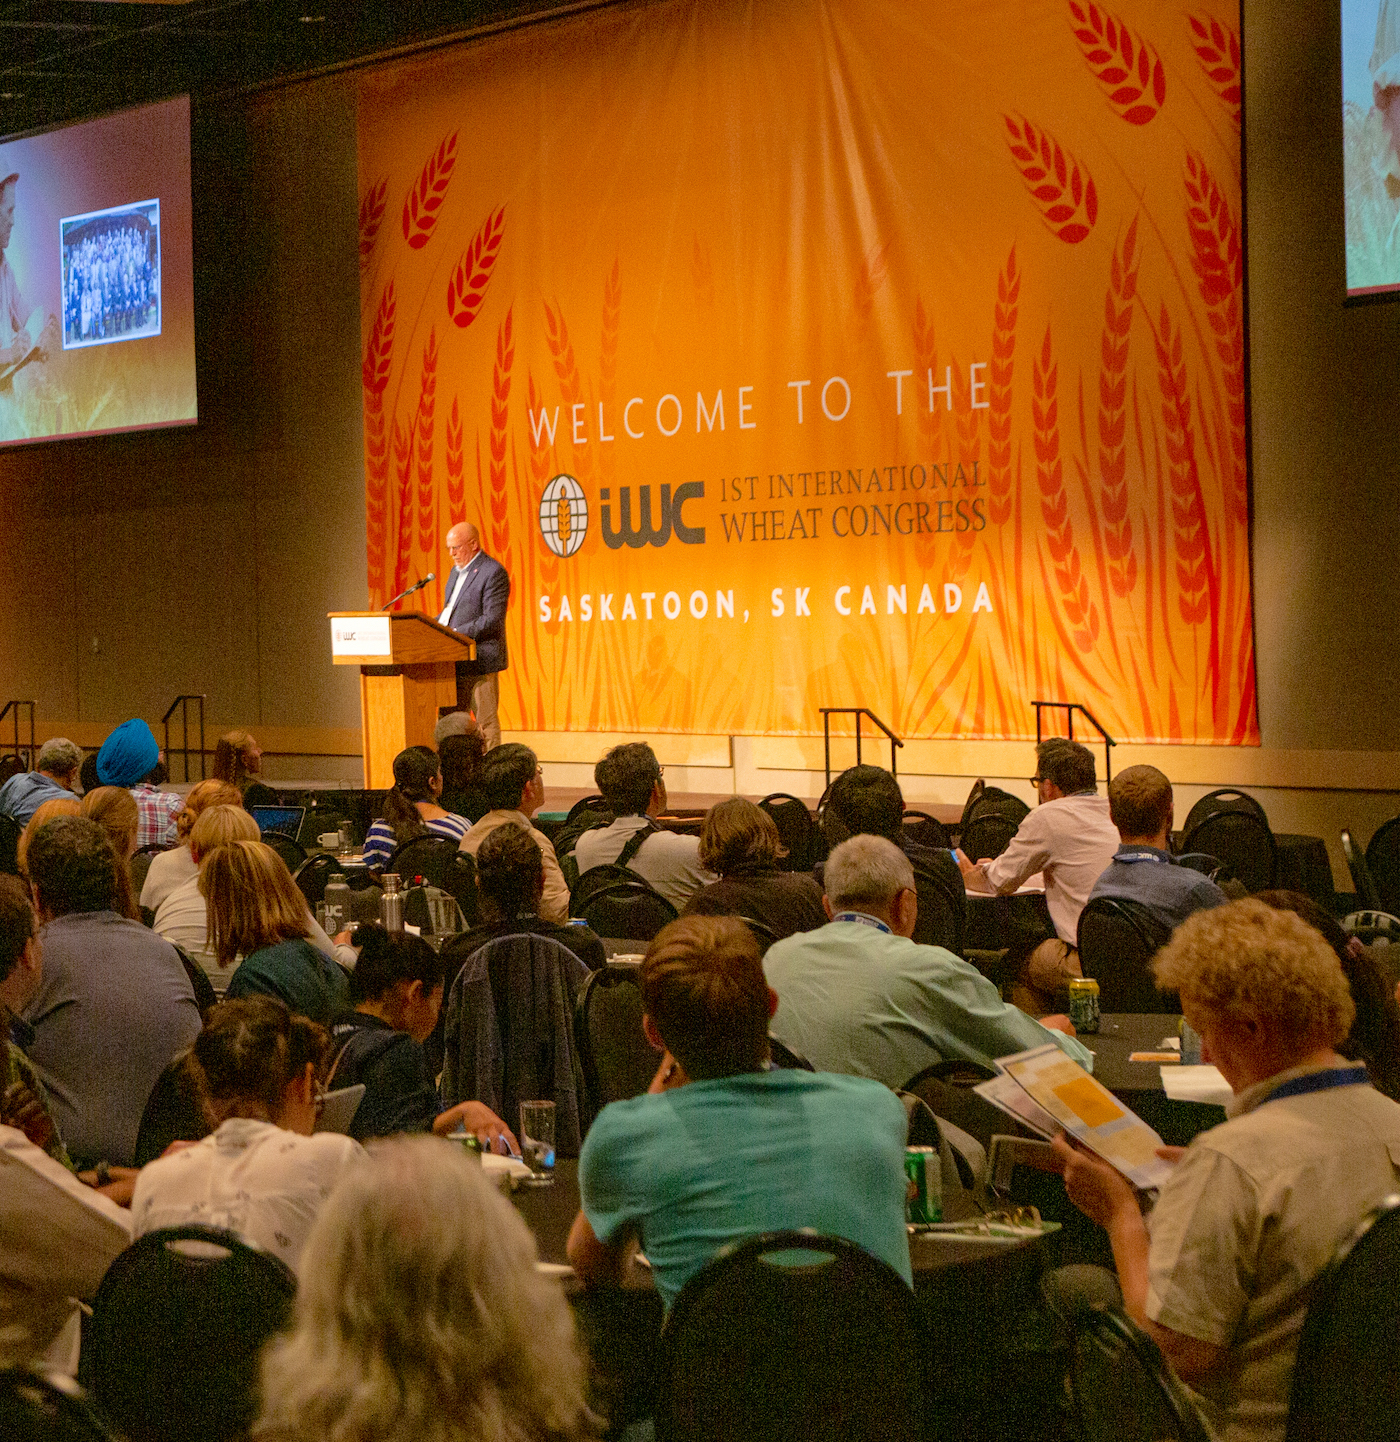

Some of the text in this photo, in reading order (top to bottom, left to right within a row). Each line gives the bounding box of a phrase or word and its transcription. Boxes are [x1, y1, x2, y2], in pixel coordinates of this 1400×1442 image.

[529, 362, 990, 448] WELCOME TO THE
[720, 461, 987, 502] 1ST INTERNATIONAL
[720, 498, 987, 543] WHEAT CONGRESS
[539, 581, 994, 624] SASKATOON, SK CANADA
